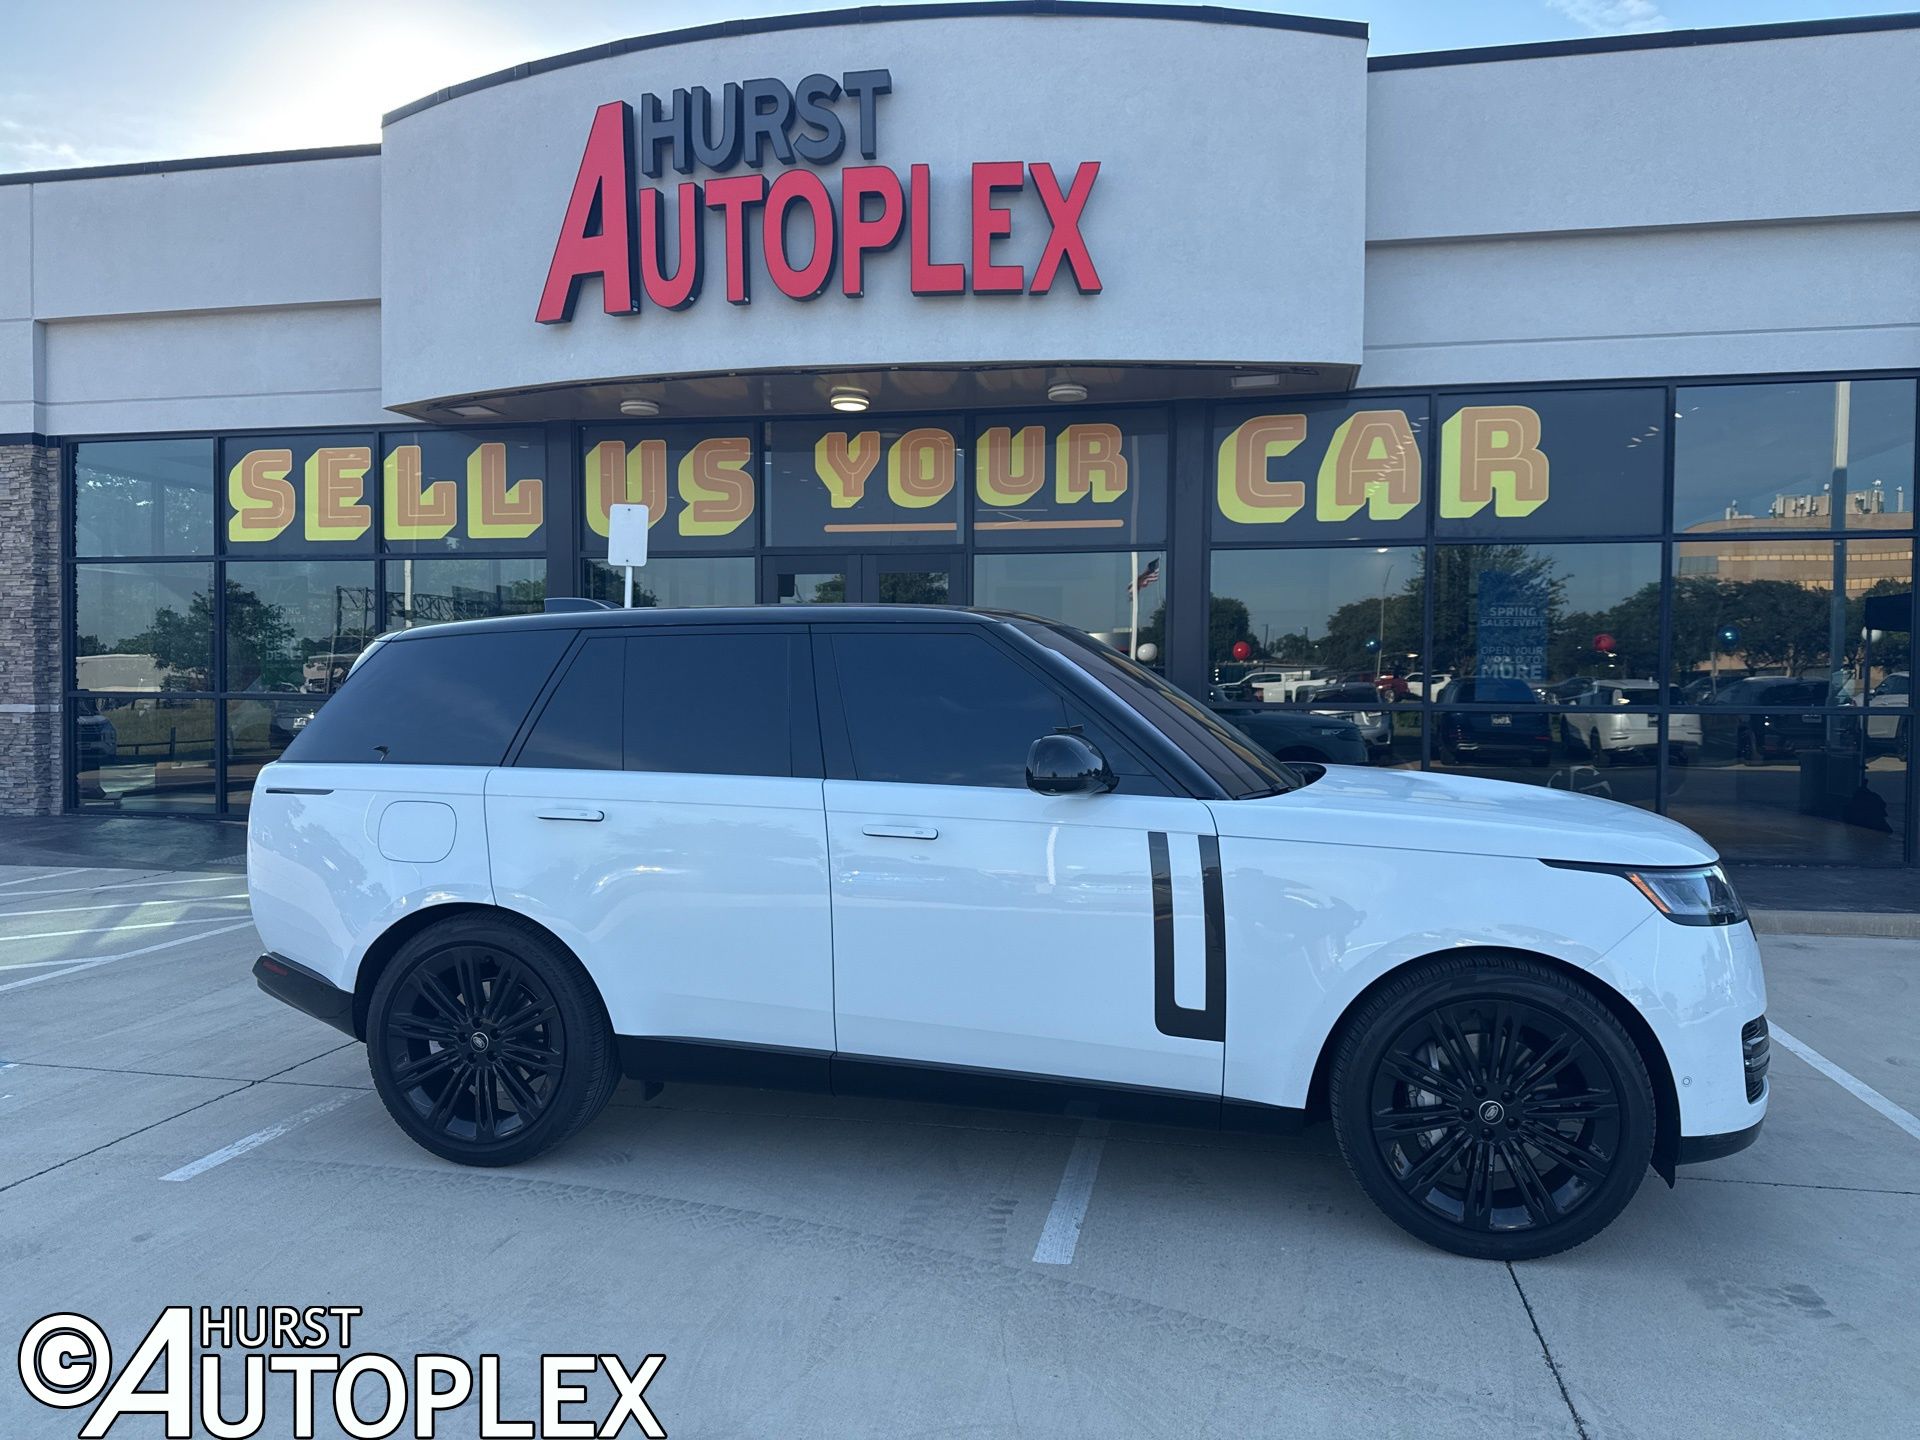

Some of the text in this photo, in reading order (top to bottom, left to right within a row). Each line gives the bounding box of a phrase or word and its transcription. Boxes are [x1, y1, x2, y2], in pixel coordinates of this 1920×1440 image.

[641, 69, 893, 178] HURST
[535, 100, 1103, 325] AUTOPLEX
[229, 406, 1549, 541] SELL US YOUR CAR
[1489, 606, 1537, 617] SPRING
[1481, 618, 1511, 627] SALES
[1480, 646, 1544, 655] OPEN YOUR
[1481, 664, 1542, 679] MORE
